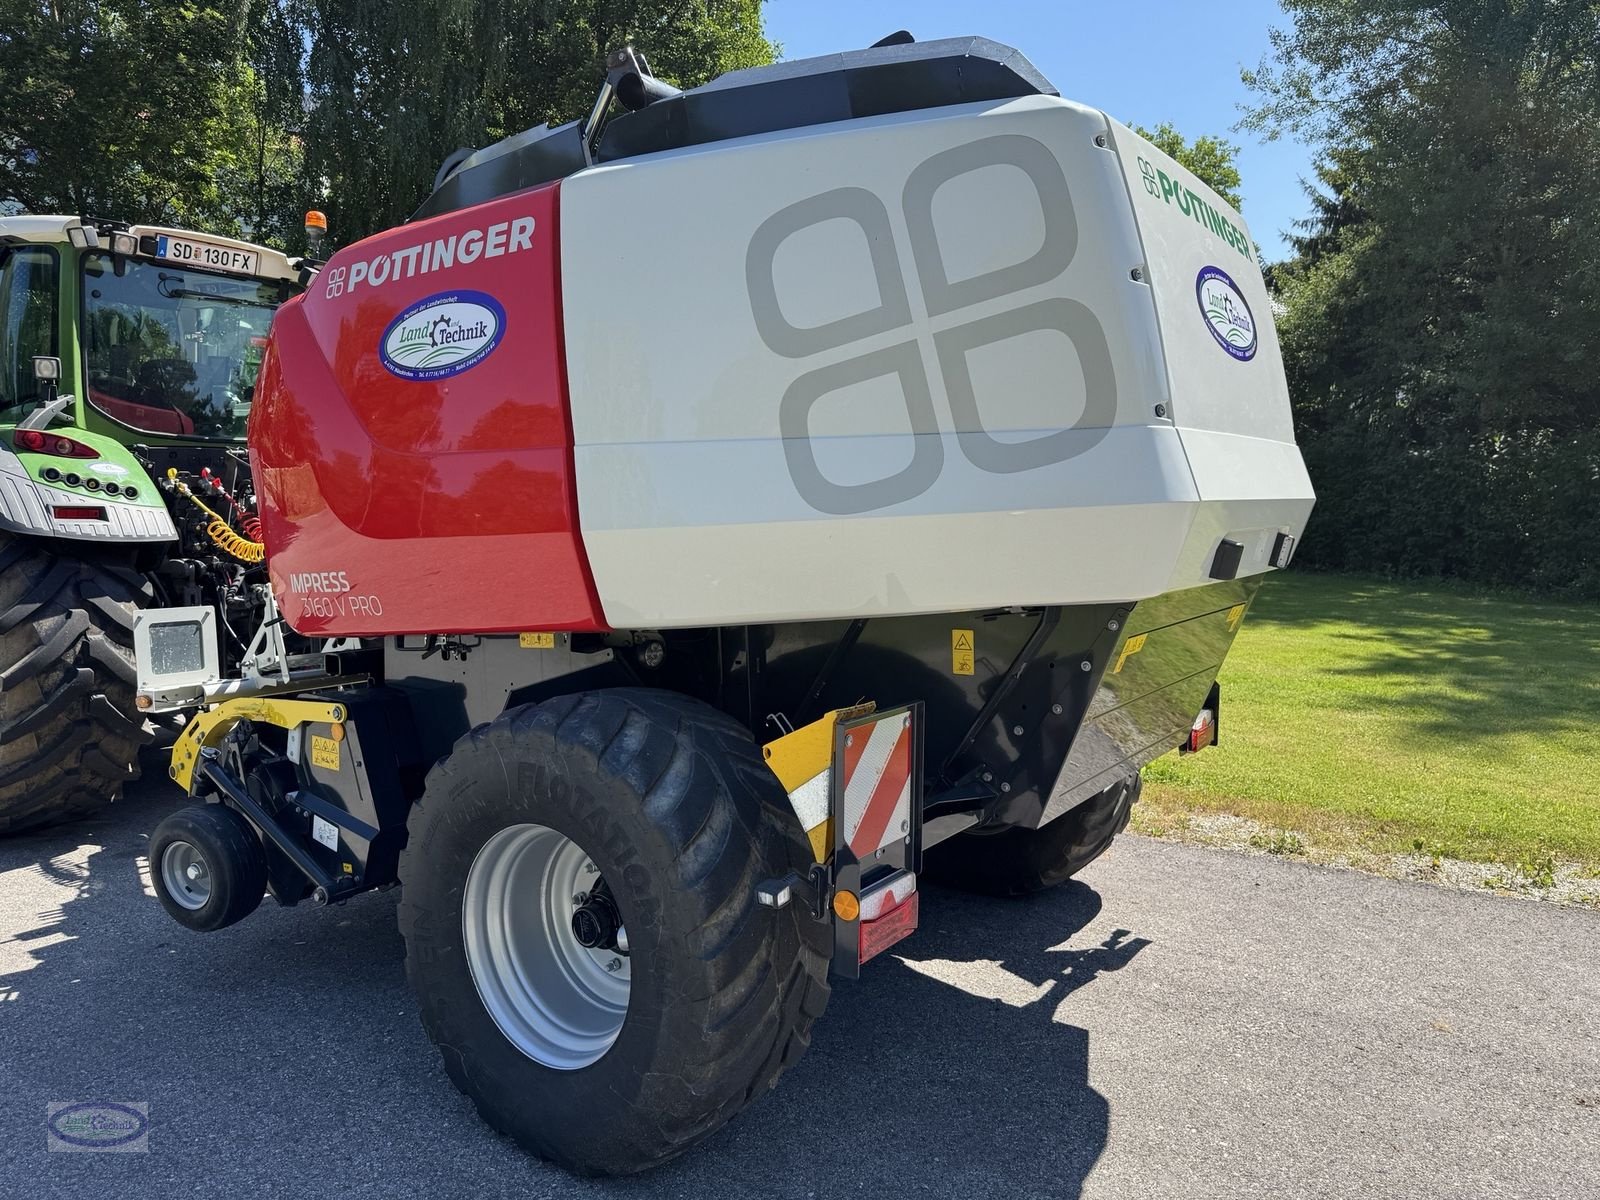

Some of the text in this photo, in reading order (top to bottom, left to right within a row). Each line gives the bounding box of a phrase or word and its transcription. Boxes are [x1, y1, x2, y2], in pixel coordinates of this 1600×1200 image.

[173, 242, 192, 259] SD
[204, 248, 229, 266] 130
[232, 253, 250, 270] FX
[347, 216, 536, 293] PÖTTINGER
[399, 321, 430, 343] Land
[439, 321, 488, 345] Technik
[290, 571, 350, 593] IMPRESS
[301, 595, 383, 617] 3160 V PRO
